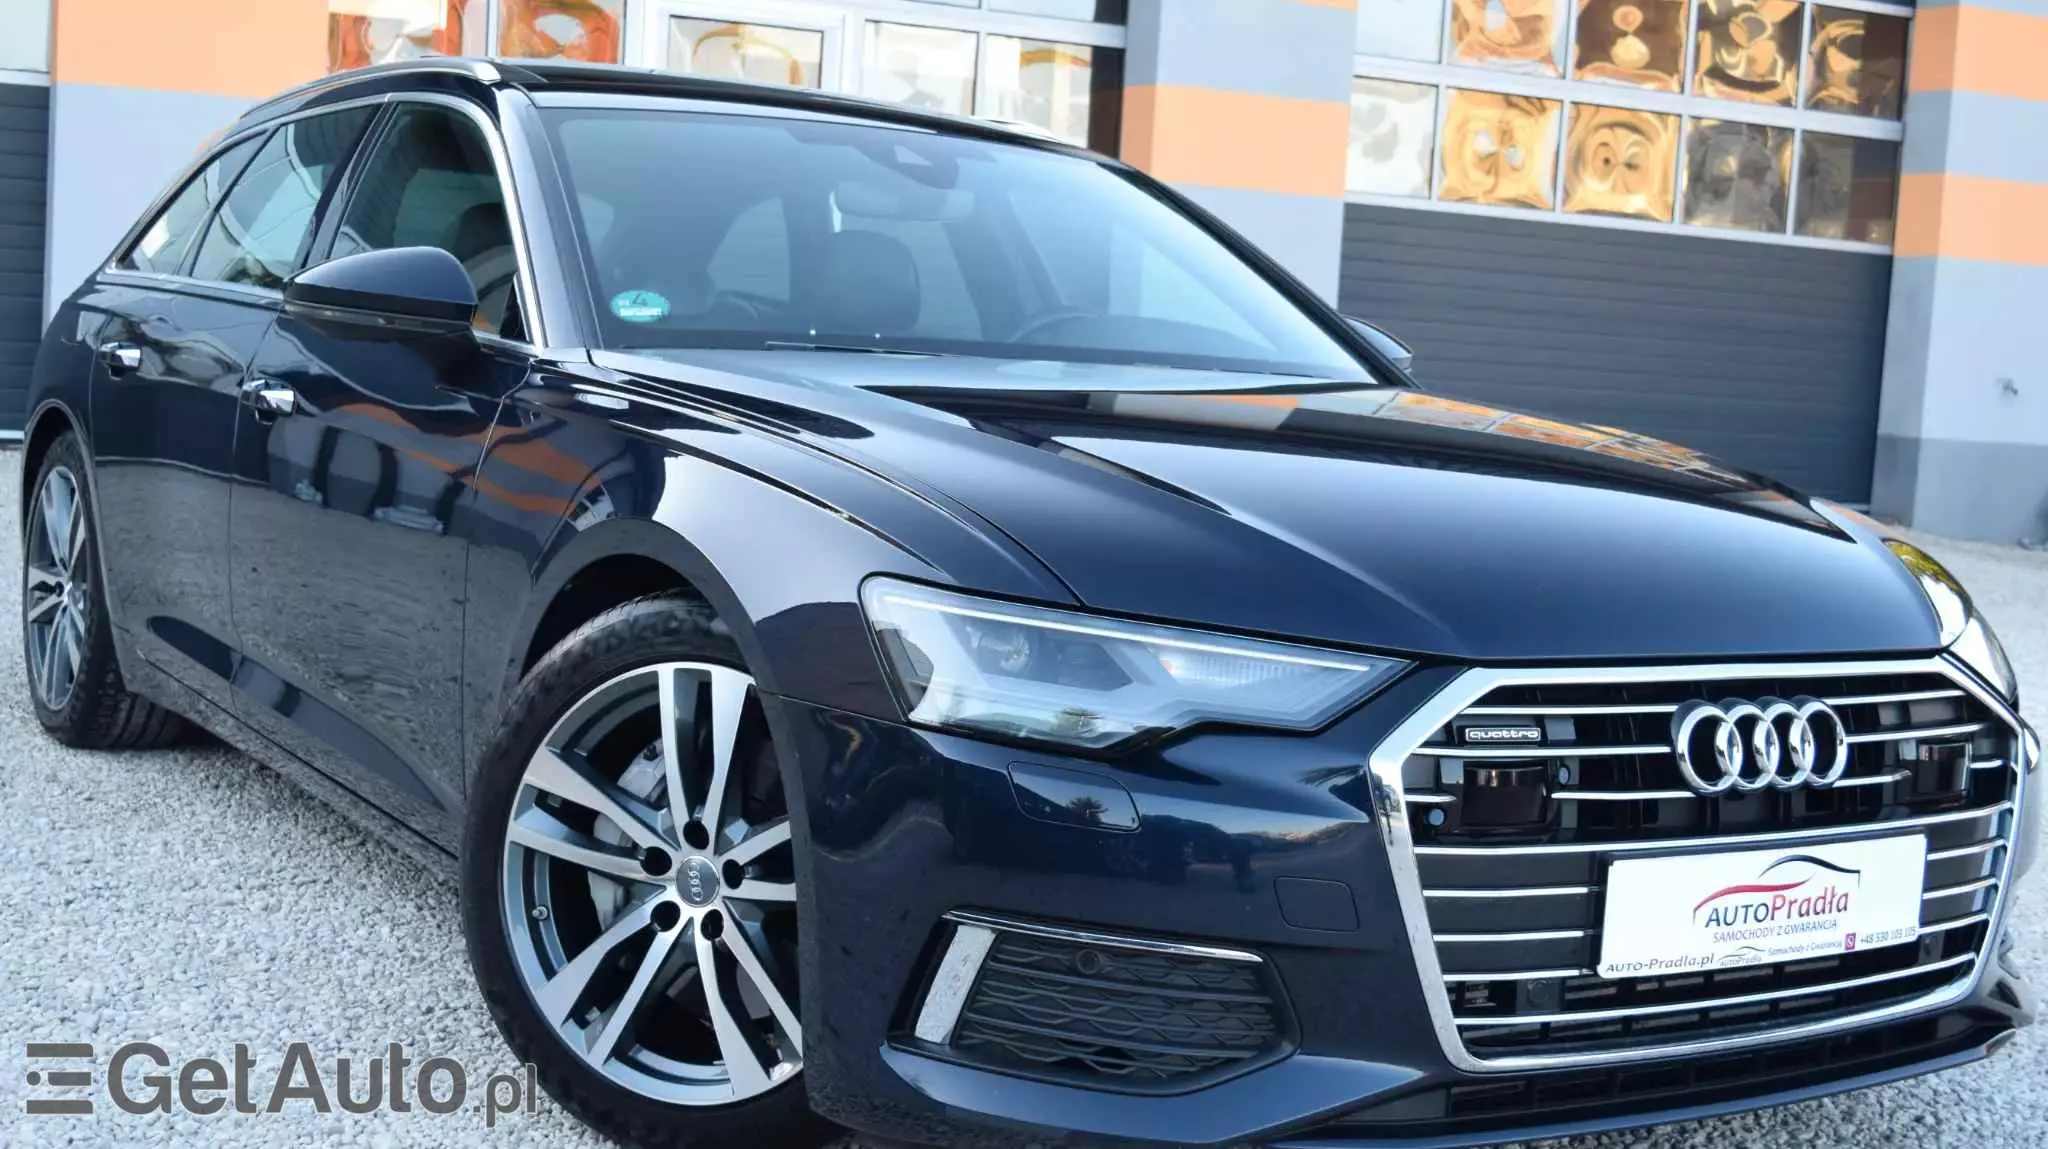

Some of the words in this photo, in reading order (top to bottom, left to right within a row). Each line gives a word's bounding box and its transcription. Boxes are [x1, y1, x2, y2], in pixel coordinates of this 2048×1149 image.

[1469, 730, 1538, 740] quattro
[1705, 885, 1849, 928] AUTOPradła
[1712, 926, 1774, 944] SAMOCHODY
[1775, 925, 1785, 936] Z
